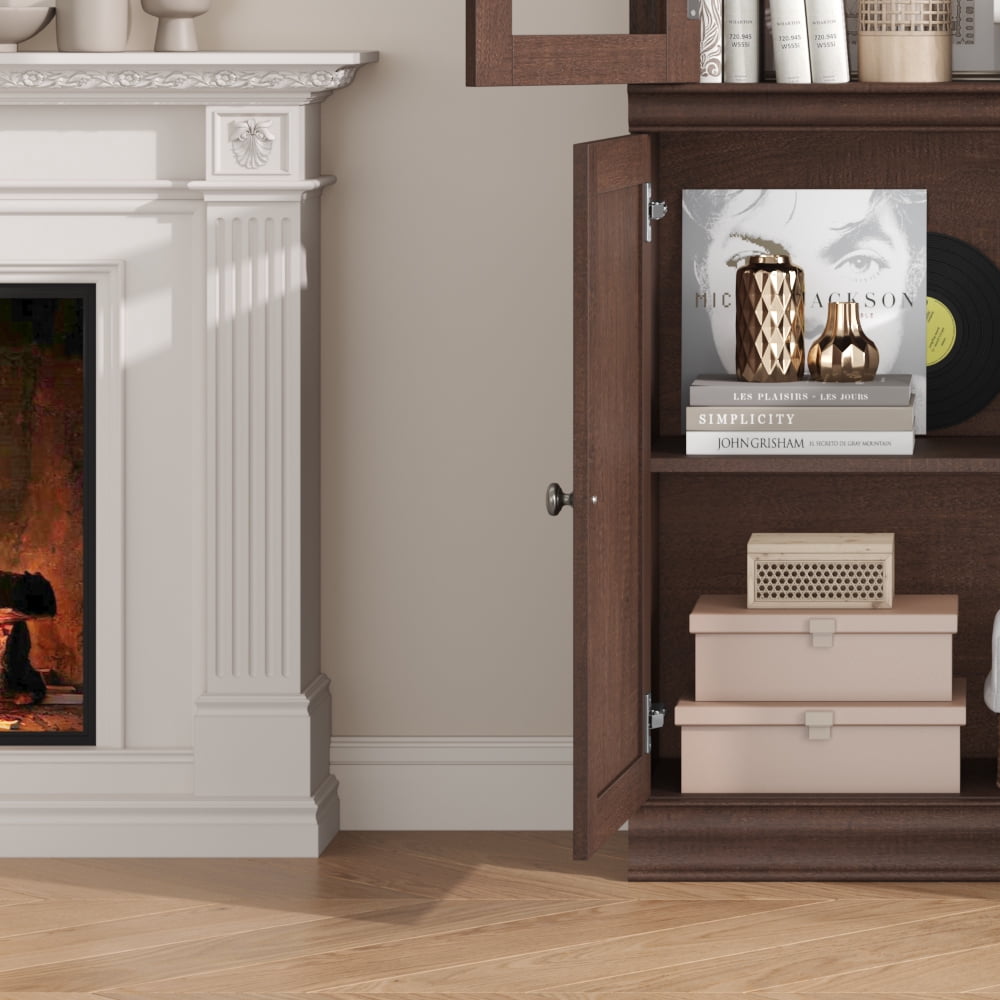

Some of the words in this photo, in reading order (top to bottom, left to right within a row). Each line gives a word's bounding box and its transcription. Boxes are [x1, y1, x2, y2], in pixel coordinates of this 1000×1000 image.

[811, 292, 914, 308] ACKSON
[733, 392, 753, 401] LES
[757, 392, 809, 401] PLAISIRS
[820, 393, 837, 401] LES
[840, 393, 869, 401] JOURS
[699, 413, 795, 425] SIMPLICITY
